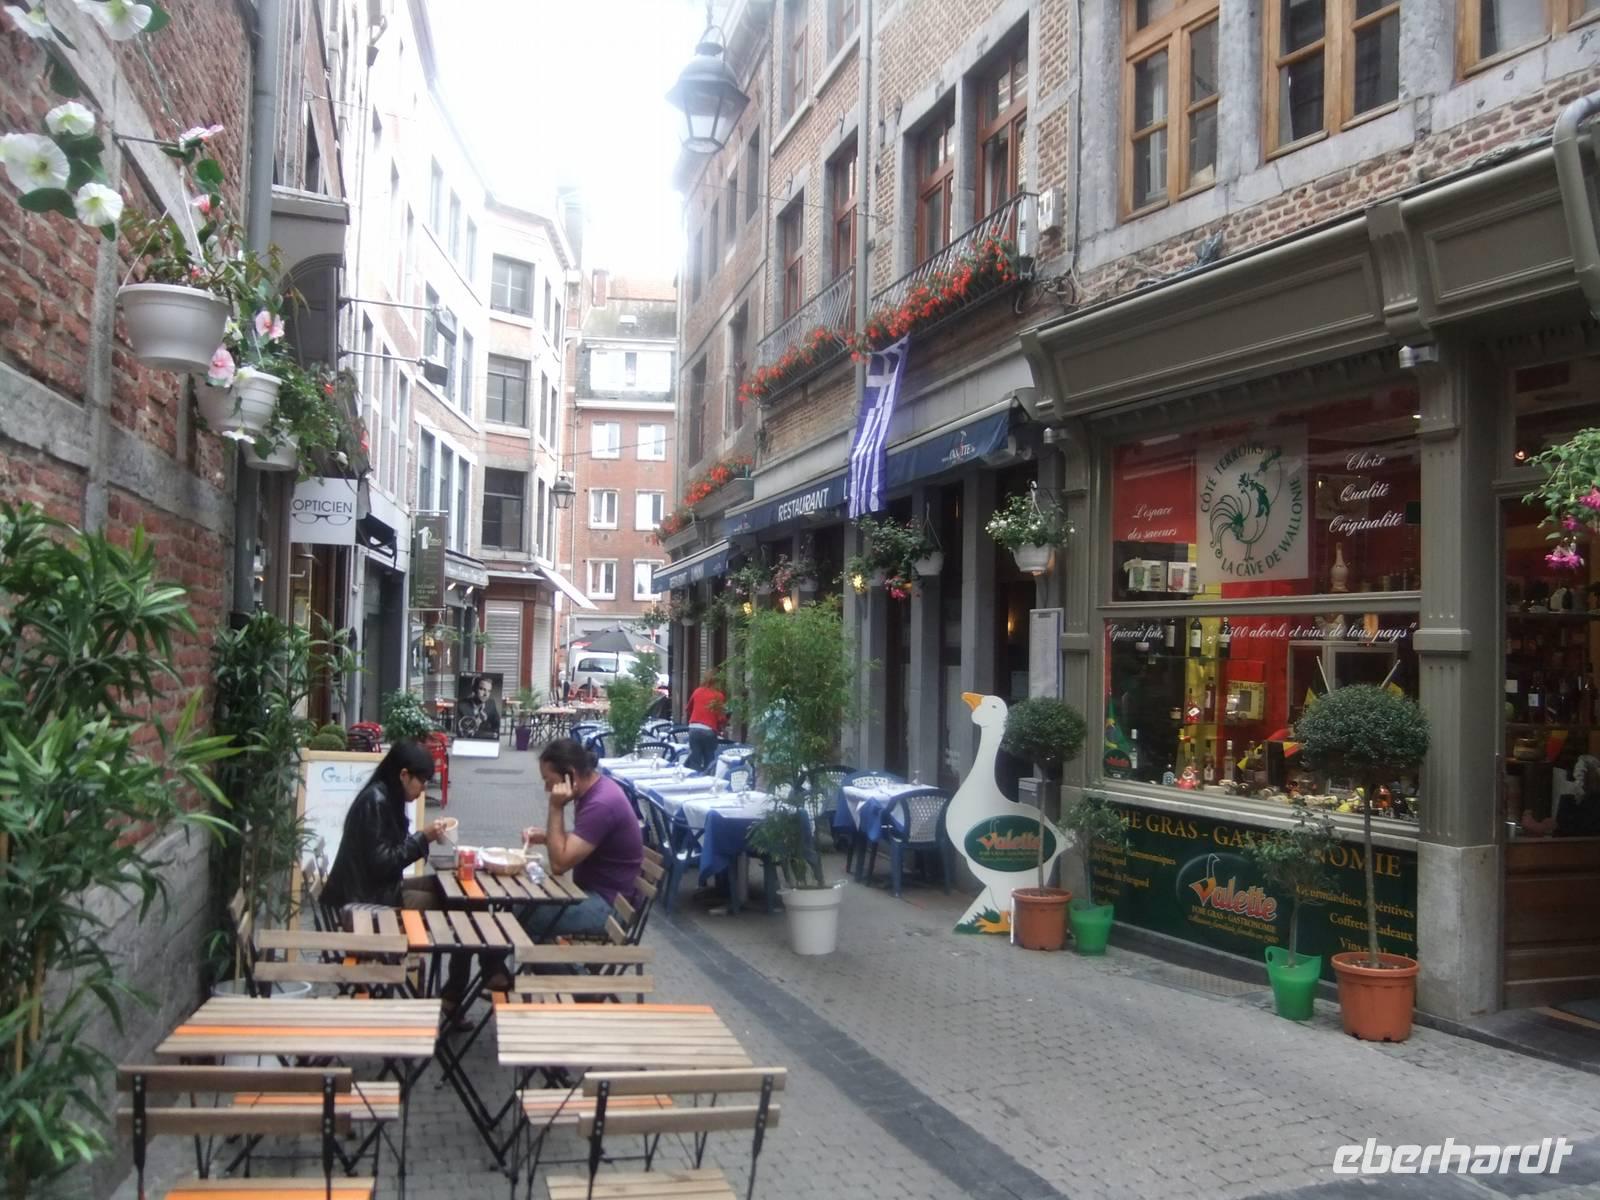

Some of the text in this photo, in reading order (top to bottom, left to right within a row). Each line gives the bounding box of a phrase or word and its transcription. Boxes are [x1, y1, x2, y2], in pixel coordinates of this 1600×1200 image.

[1214, 442, 1265, 475] TERROIRS
[1346, 452, 1386, 471] Choix
[778, 487, 829, 522] RESTAURANT
[1340, 482, 1390, 502] Qualité
[292, 499, 353, 513] OPTICIEN
[1328, 510, 1404, 537] Originalité
[1221, 558, 1234, 575] LA
[1236, 560, 1264, 577] CAVE
[1265, 550, 1281, 569] DE
[1249, 623, 1286, 639] alcools
[1288, 624, 1302, 639] et
[1302, 626, 1326, 639] vins
[1328, 624, 1344, 639] de
[1346, 624, 1371, 640] tous
[1146, 814, 1198, 839] GRAS
[1188, 876, 1277, 922] Valette
